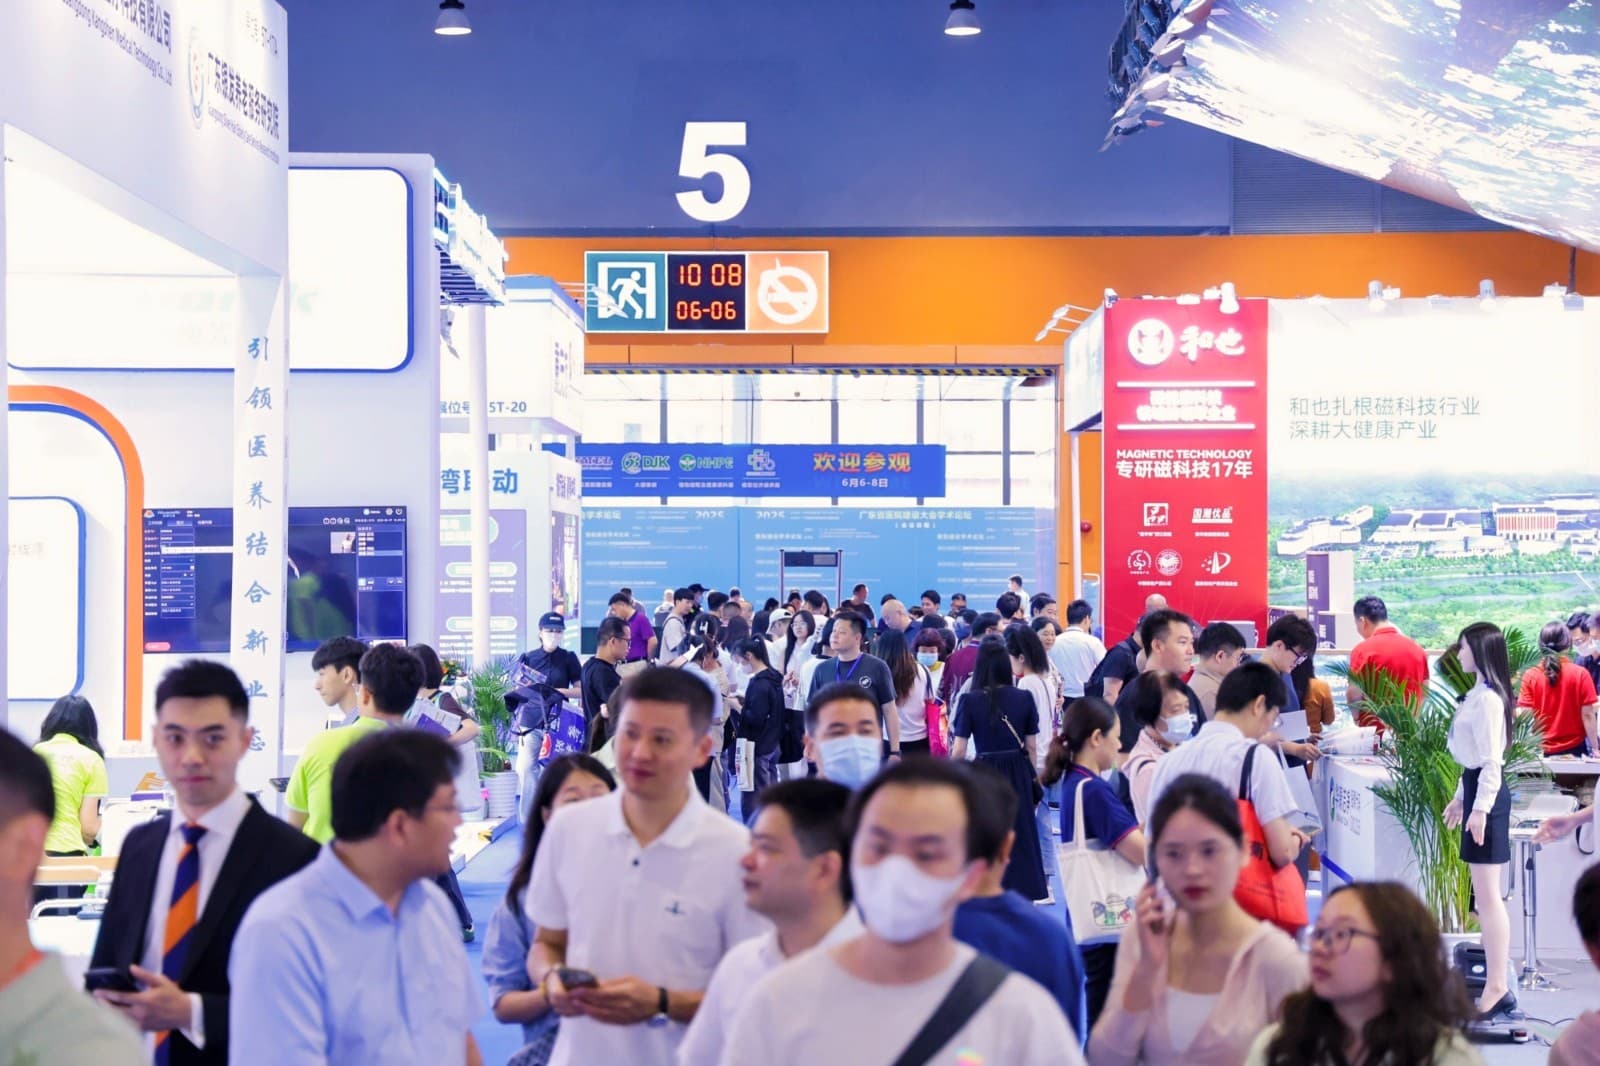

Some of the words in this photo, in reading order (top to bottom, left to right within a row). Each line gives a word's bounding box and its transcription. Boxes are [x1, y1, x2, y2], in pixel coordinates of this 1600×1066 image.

[675, 121, 751, 222] 5
[679, 263, 701, 287] 10
[711, 263, 742, 287] 08
[676, 301, 737, 320] 06-06
[1179, 325, 1246, 362] 和也
[489, 401, 527, 413] 5T-20
[1289, 396, 1481, 417] 和也扎根磁科技行业
[1289, 420, 1438, 440] 深耕大健康产业
[642, 455, 670, 469] DJK
[813, 452, 912, 473] 欢迎参观
[1116, 449, 1174, 459] MAGNETIC
[1176, 449, 1253, 459] TECHNOLOGY
[1116, 460, 1254, 479] 专研磁科技17年
[841, 478, 888, 488] 6月6-8日
